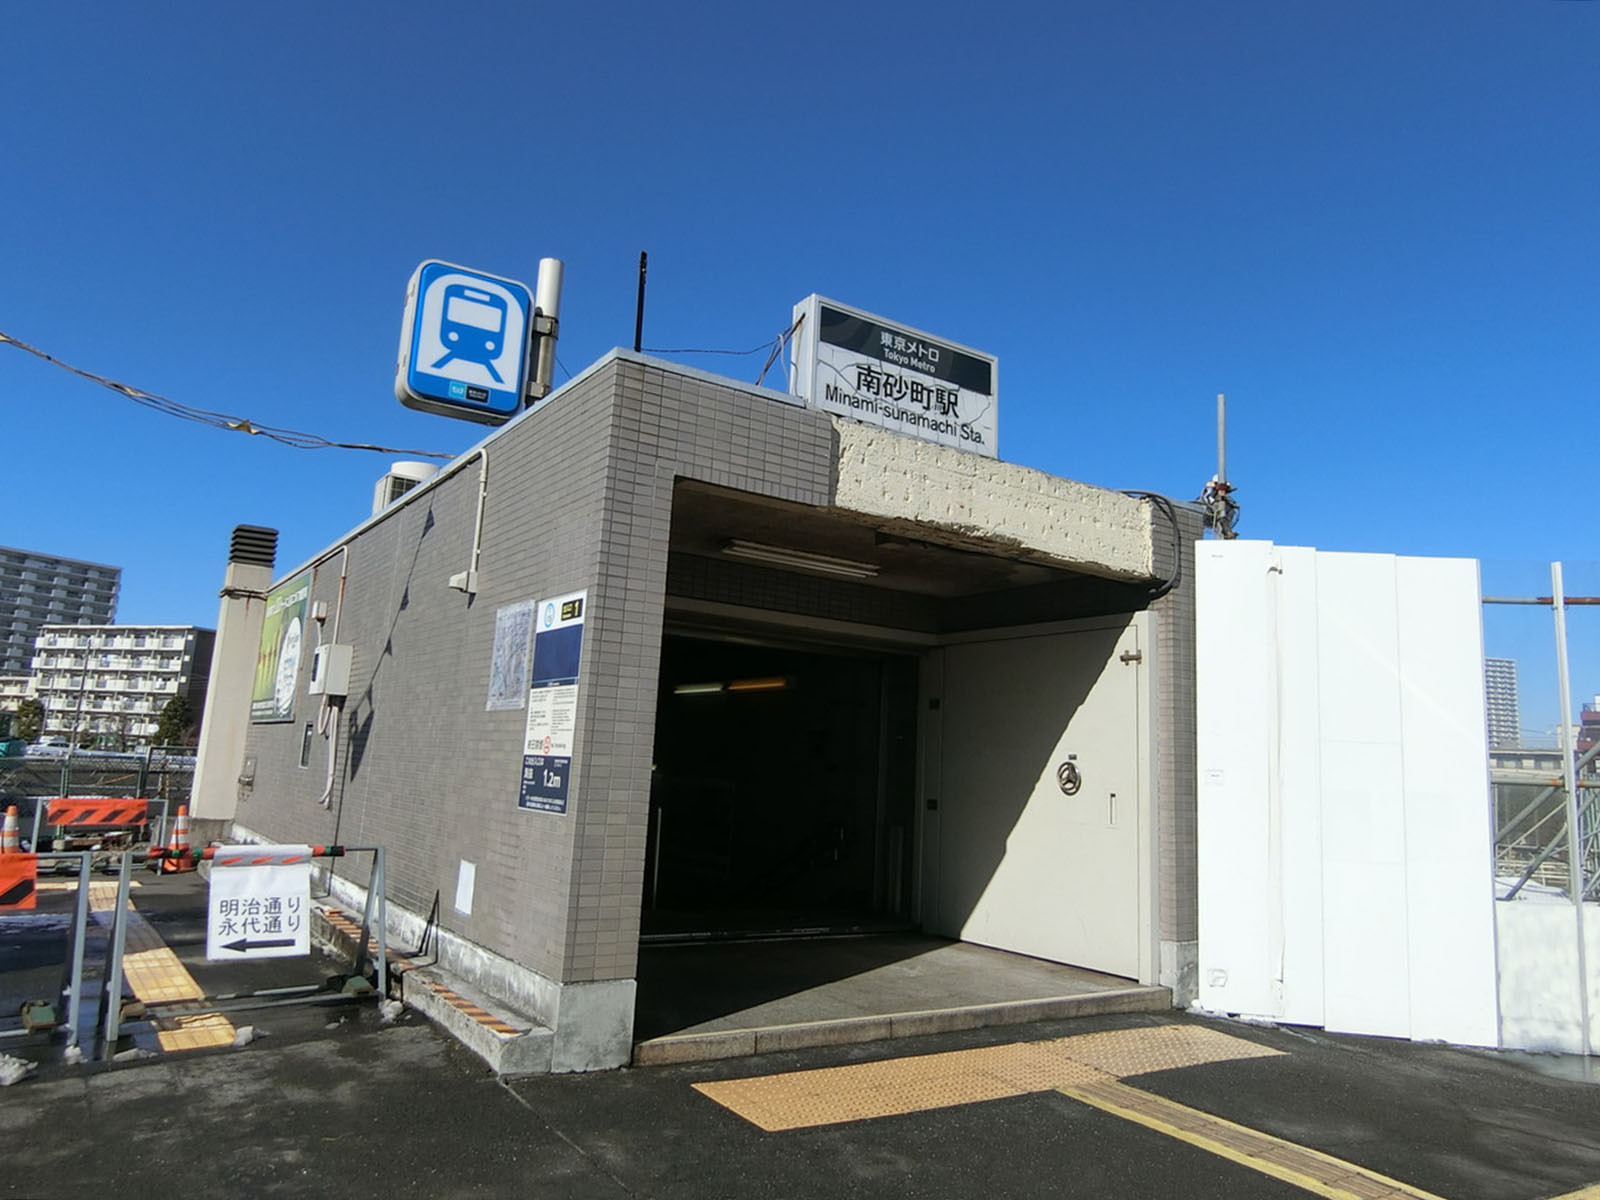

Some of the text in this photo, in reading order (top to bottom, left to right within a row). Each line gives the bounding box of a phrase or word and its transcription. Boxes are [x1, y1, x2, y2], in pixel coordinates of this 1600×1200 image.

[880, 331, 940, 362] 東京メトロ
[883, 348, 936, 374] Tokyo Metro
[856, 365, 960, 418] 南砂町駅
[825, 384, 985, 444] Minami-sunamachi Sta.
[574, 600, 580, 617] 1
[219, 896, 301, 917] 明治通り
[218, 915, 301, 936] 永代通り
